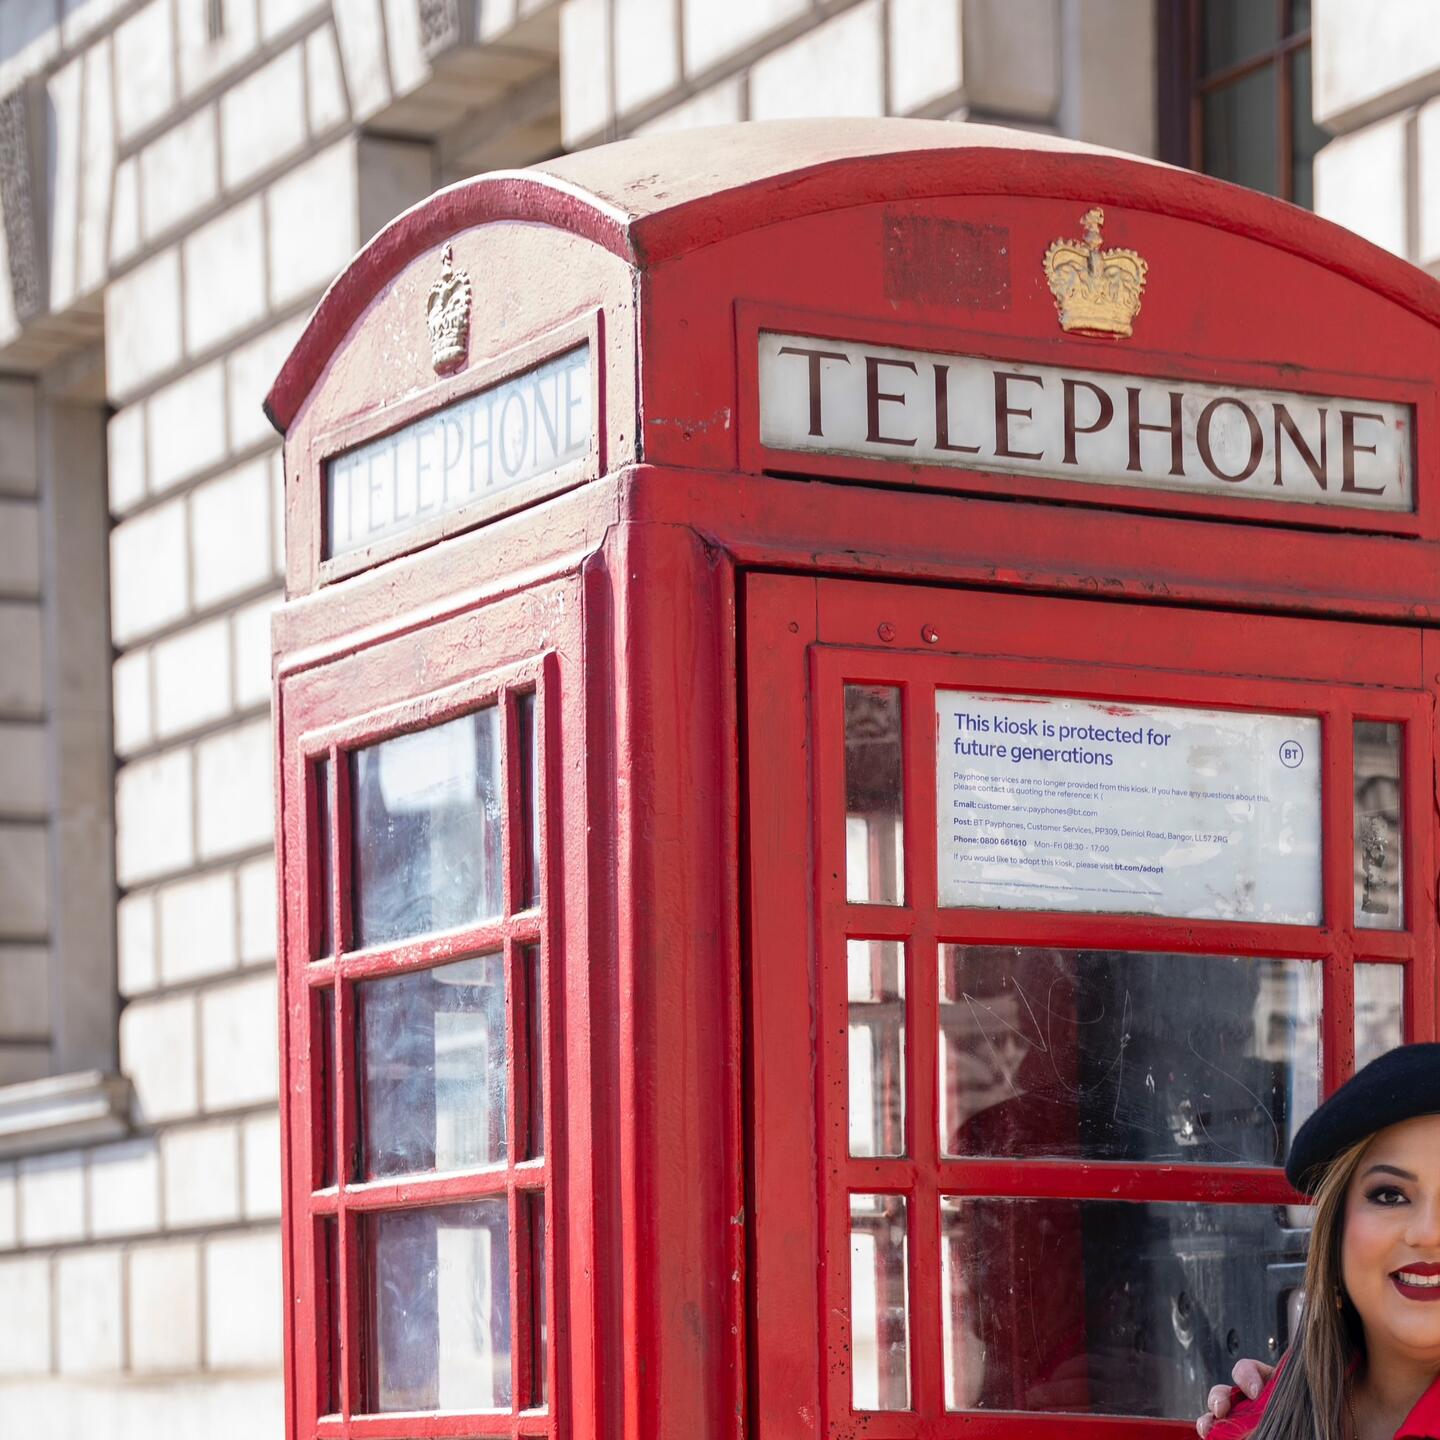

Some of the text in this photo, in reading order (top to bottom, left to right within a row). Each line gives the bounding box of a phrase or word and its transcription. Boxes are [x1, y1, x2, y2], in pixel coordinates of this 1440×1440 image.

[777, 346, 1386, 496] TELEPHONE
[335, 365, 586, 542] TELEPHONE
[954, 712, 1171, 746] This kiosk is protected for
[954, 737, 1114, 766] future generations
[1284, 748, 1299, 760] BT
[953, 772, 989, 783] Payphone
[990, 775, 1019, 785] services
[1043, 778, 1066, 789] longer
[1067, 780, 1098, 790] provided
[1100, 783, 1116, 791] from
[1118, 784, 1130, 793] this
[1131, 784, 1151, 793] kiosk.
[1151, 785, 1157, 793] If
[1158, 788, 1170, 796] you
[1171, 788, 1188, 796] have
[1202, 790, 1234, 801] questions
[1236, 793, 1256, 801] about
[953, 783, 976, 793] please
[977, 785, 1005, 793] contact
[1016, 787, 1043, 798] quoting
[1044, 788, 1056, 797] the
[1057, 789, 1093, 800] reference:
[1093, 792, 1099, 800] K
[953, 799, 976, 809] Email:
[953, 817, 973, 826] Post:
[984, 820, 1026, 830] Payphones,
[1026, 822, 1061, 832] Customer
[1062, 825, 1094, 835] Services,
[1094, 827, 1119, 837] PP309,
[1121, 828, 1146, 838] Deiniol
[1146, 830, 1167, 840] Road,
[1168, 833, 1194, 842] Bangor,
[1194, 834, 1212, 842] LL57
[953, 835, 979, 844] Phone:
[980, 837, 999, 845] 0800
[1000, 838, 1027, 847] 661610
[1033, 840, 1062, 849] Mon-Fri
[1063, 842, 1083, 851] 08:30
[1091, 844, 1110, 852] 17:00
[959, 855, 973, 864] you
[973, 855, 996, 863] would
[996, 855, 1009, 864] like
[1010, 856, 1018, 864] to
[1018, 857, 1040, 867] adopt
[1041, 858, 1053, 866] this
[1075, 861, 1099, 871] please
[1099, 862, 1114, 870] visit
[1114, 863, 1164, 874] bt.com/adopt
